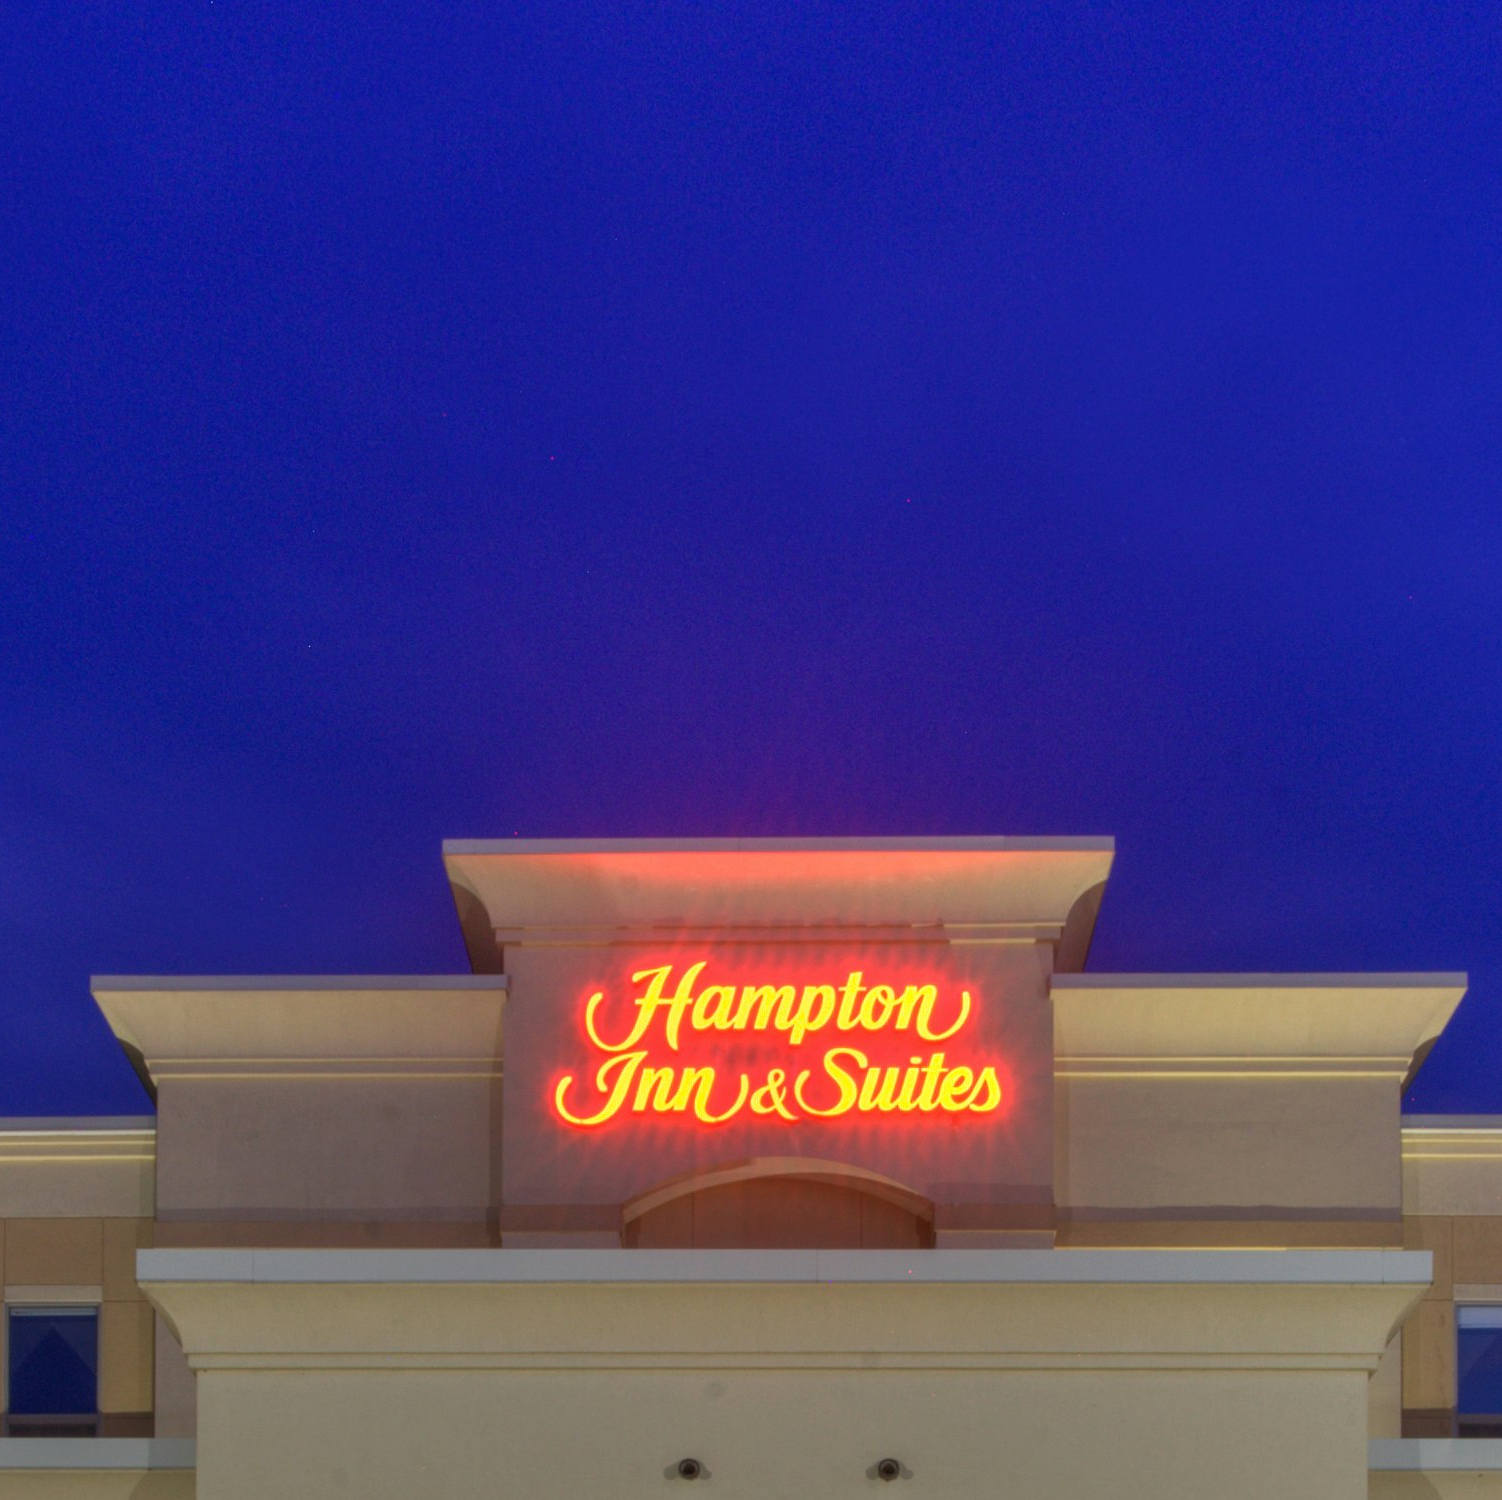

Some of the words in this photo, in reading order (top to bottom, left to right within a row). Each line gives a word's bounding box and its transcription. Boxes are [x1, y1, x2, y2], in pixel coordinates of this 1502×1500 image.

[586, 961, 971, 1052] Hampton
[555, 1051, 749, 1125] Inn
[749, 1068, 799, 1120] &
[795, 1048, 1002, 1117] Suites
